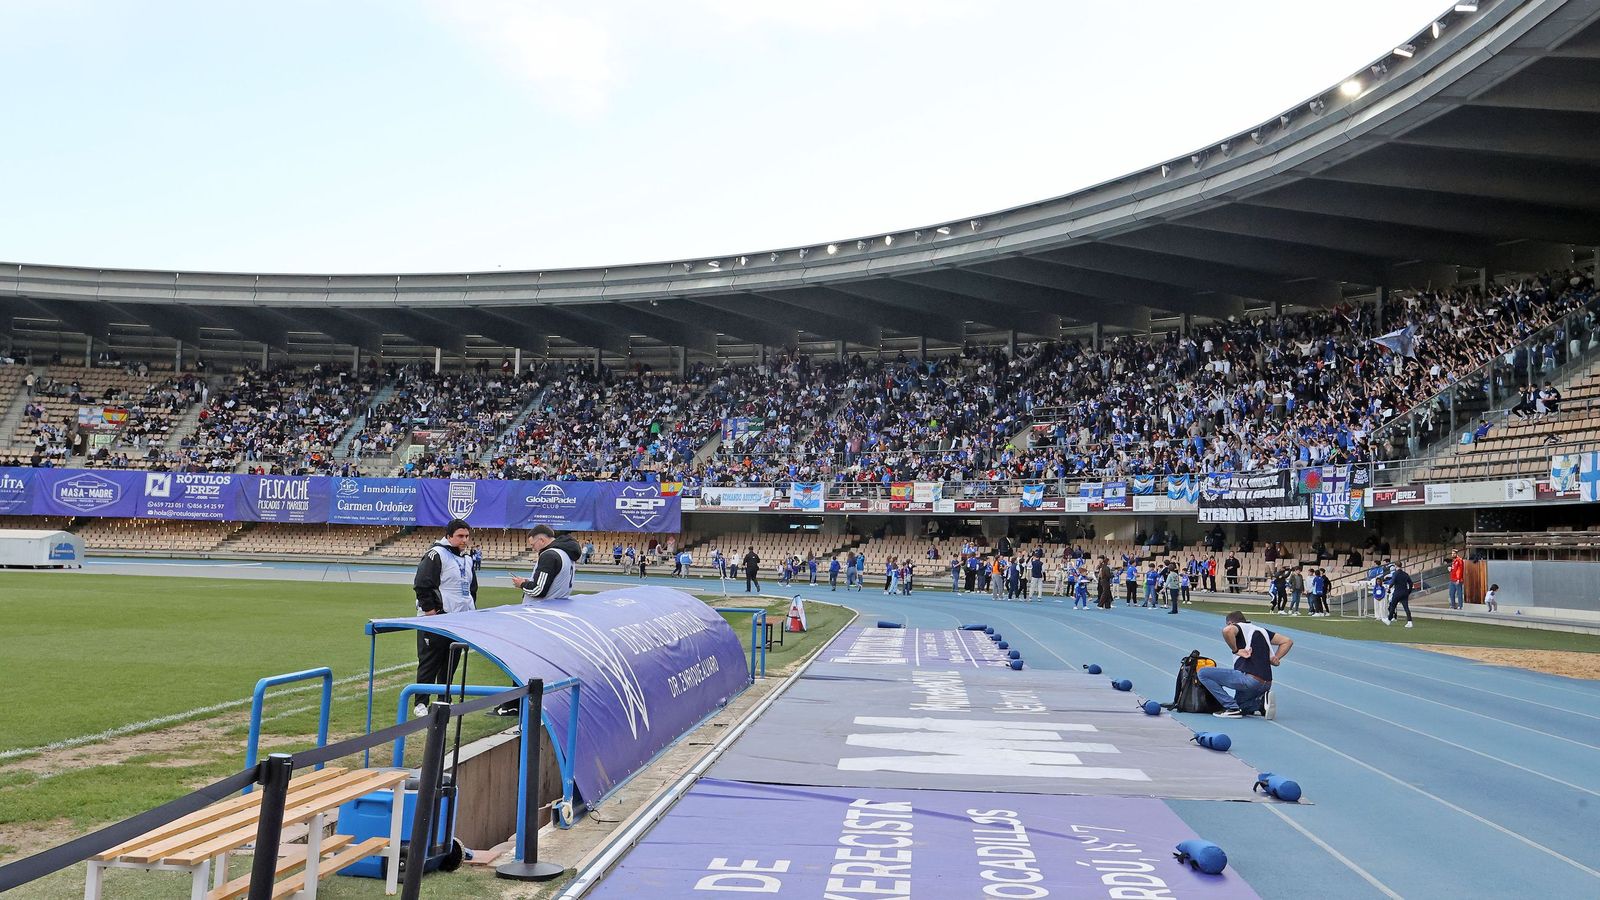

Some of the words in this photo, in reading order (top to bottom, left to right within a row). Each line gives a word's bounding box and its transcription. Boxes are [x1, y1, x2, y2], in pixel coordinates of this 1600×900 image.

[176, 473, 231, 485] RÓTULOS
[61, 488, 113, 498] MASA-MADRE
[185, 485, 220, 495] JEREZ
[259, 477, 310, 500] PESCACHÉ
[363, 485, 417, 494] Inmobiliaria
[525, 495, 577, 504] GlobalPadel
[1315, 493, 1324, 505] EL
[1326, 493, 1350, 505] XIKLE
[1376, 492, 1394, 500] PLAY
[258, 500, 280, 510] PESCADOS
[286, 501, 310, 511] MARISCOS
[337, 499, 373, 512] Carmen
[615, 498, 665, 510] DSP
[154, 509, 223, 519] hola@rotulosjerez.com
[1199, 507, 1245, 521] ETERNO
[1246, 506, 1309, 521] FRESNEDA
[1315, 505, 1346, 516] FANS
[966, 808, 1050, 899] OCADILLOS
[693, 857, 791, 894] DE
[1076, 857, 1177, 900] RDÚ,
